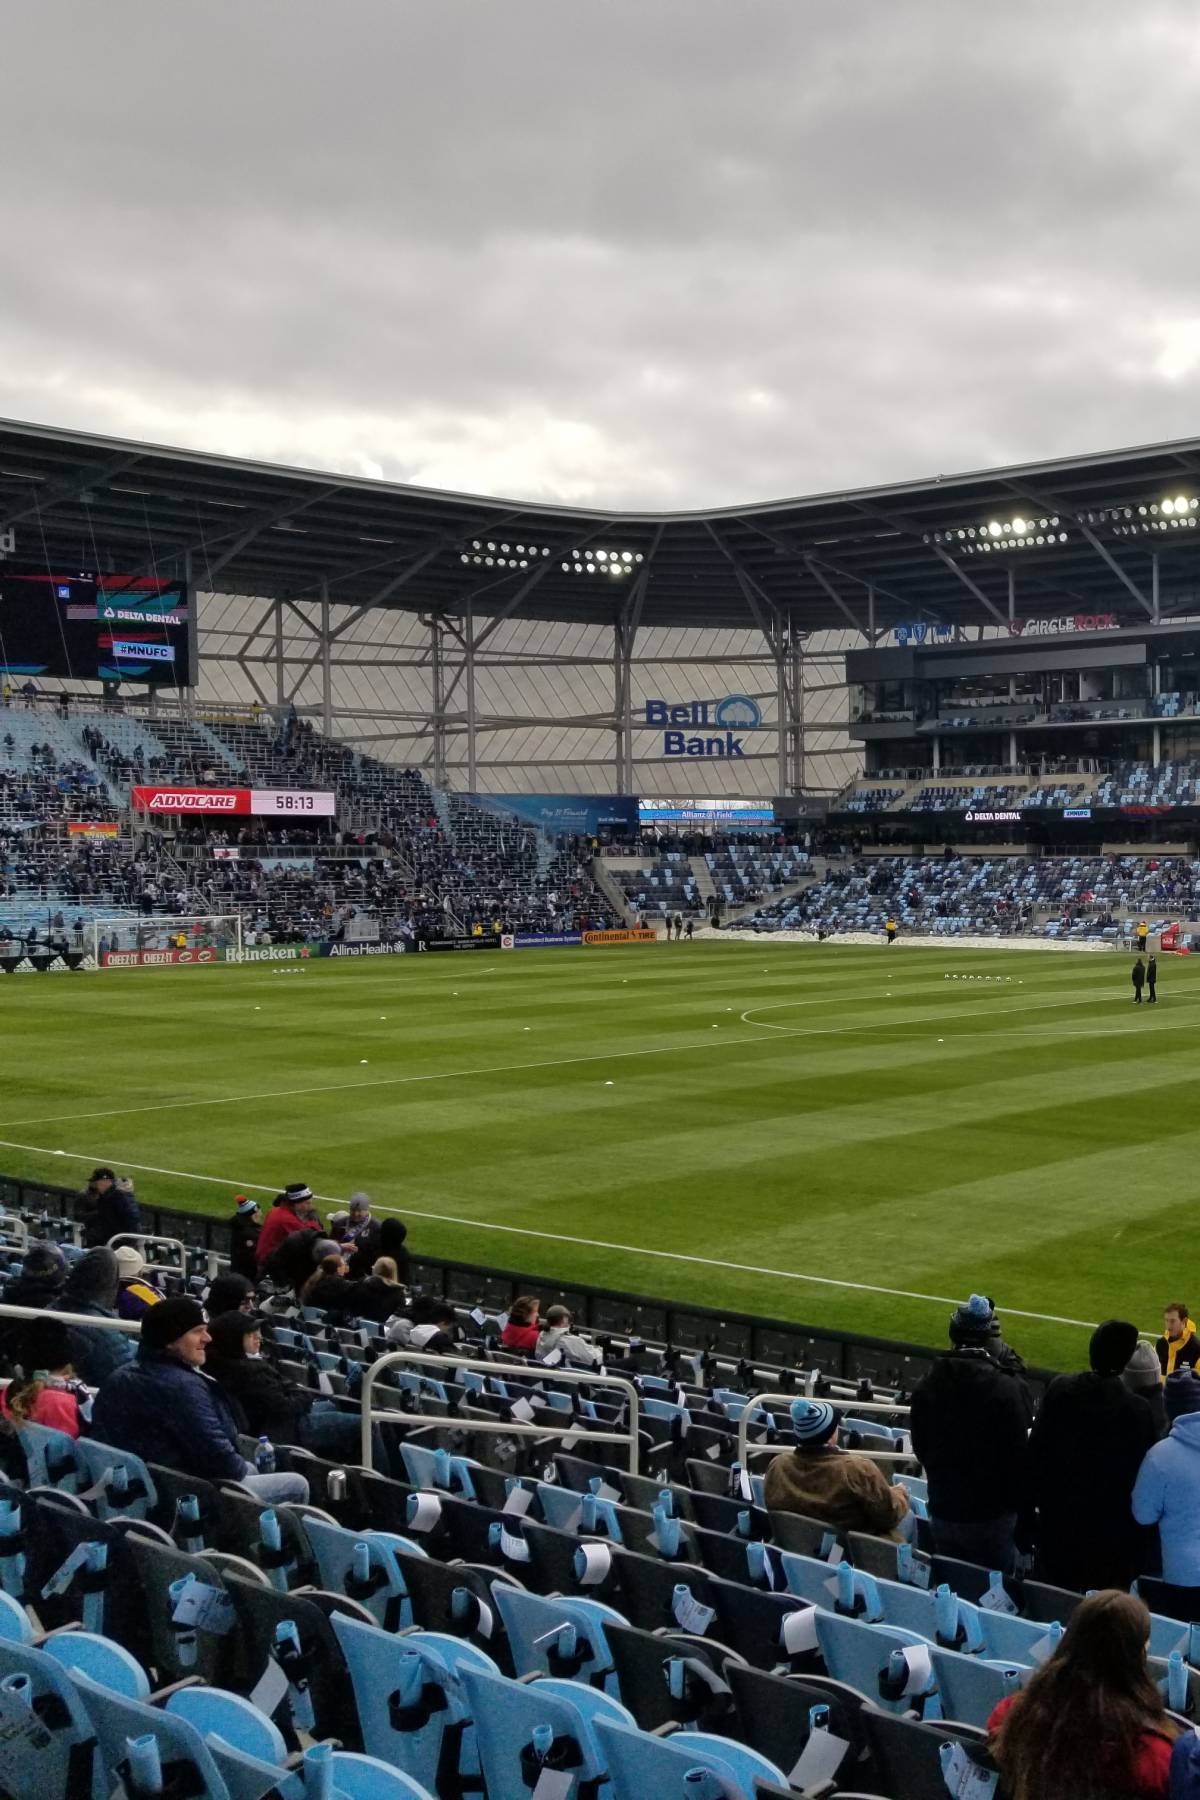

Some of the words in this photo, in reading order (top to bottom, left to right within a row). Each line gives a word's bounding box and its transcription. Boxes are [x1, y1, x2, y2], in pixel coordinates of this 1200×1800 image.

[117, 610, 145, 622] DELTA
[146, 613, 181, 625] DENTAL
[120, 644, 168, 658] #MNUFC
[646, 700, 708, 726] Bell
[664, 731, 744, 755] Bank
[150, 794, 236, 808] ADVOCARE
[276, 796, 314, 810] 58:13
[682, 811, 706, 819] Allianz
[974, 812, 993, 820] DELTA
[995, 811, 1020, 820] DENTAL
[585, 932, 630, 943] Continental
[225, 946, 296, 960] Heineken
